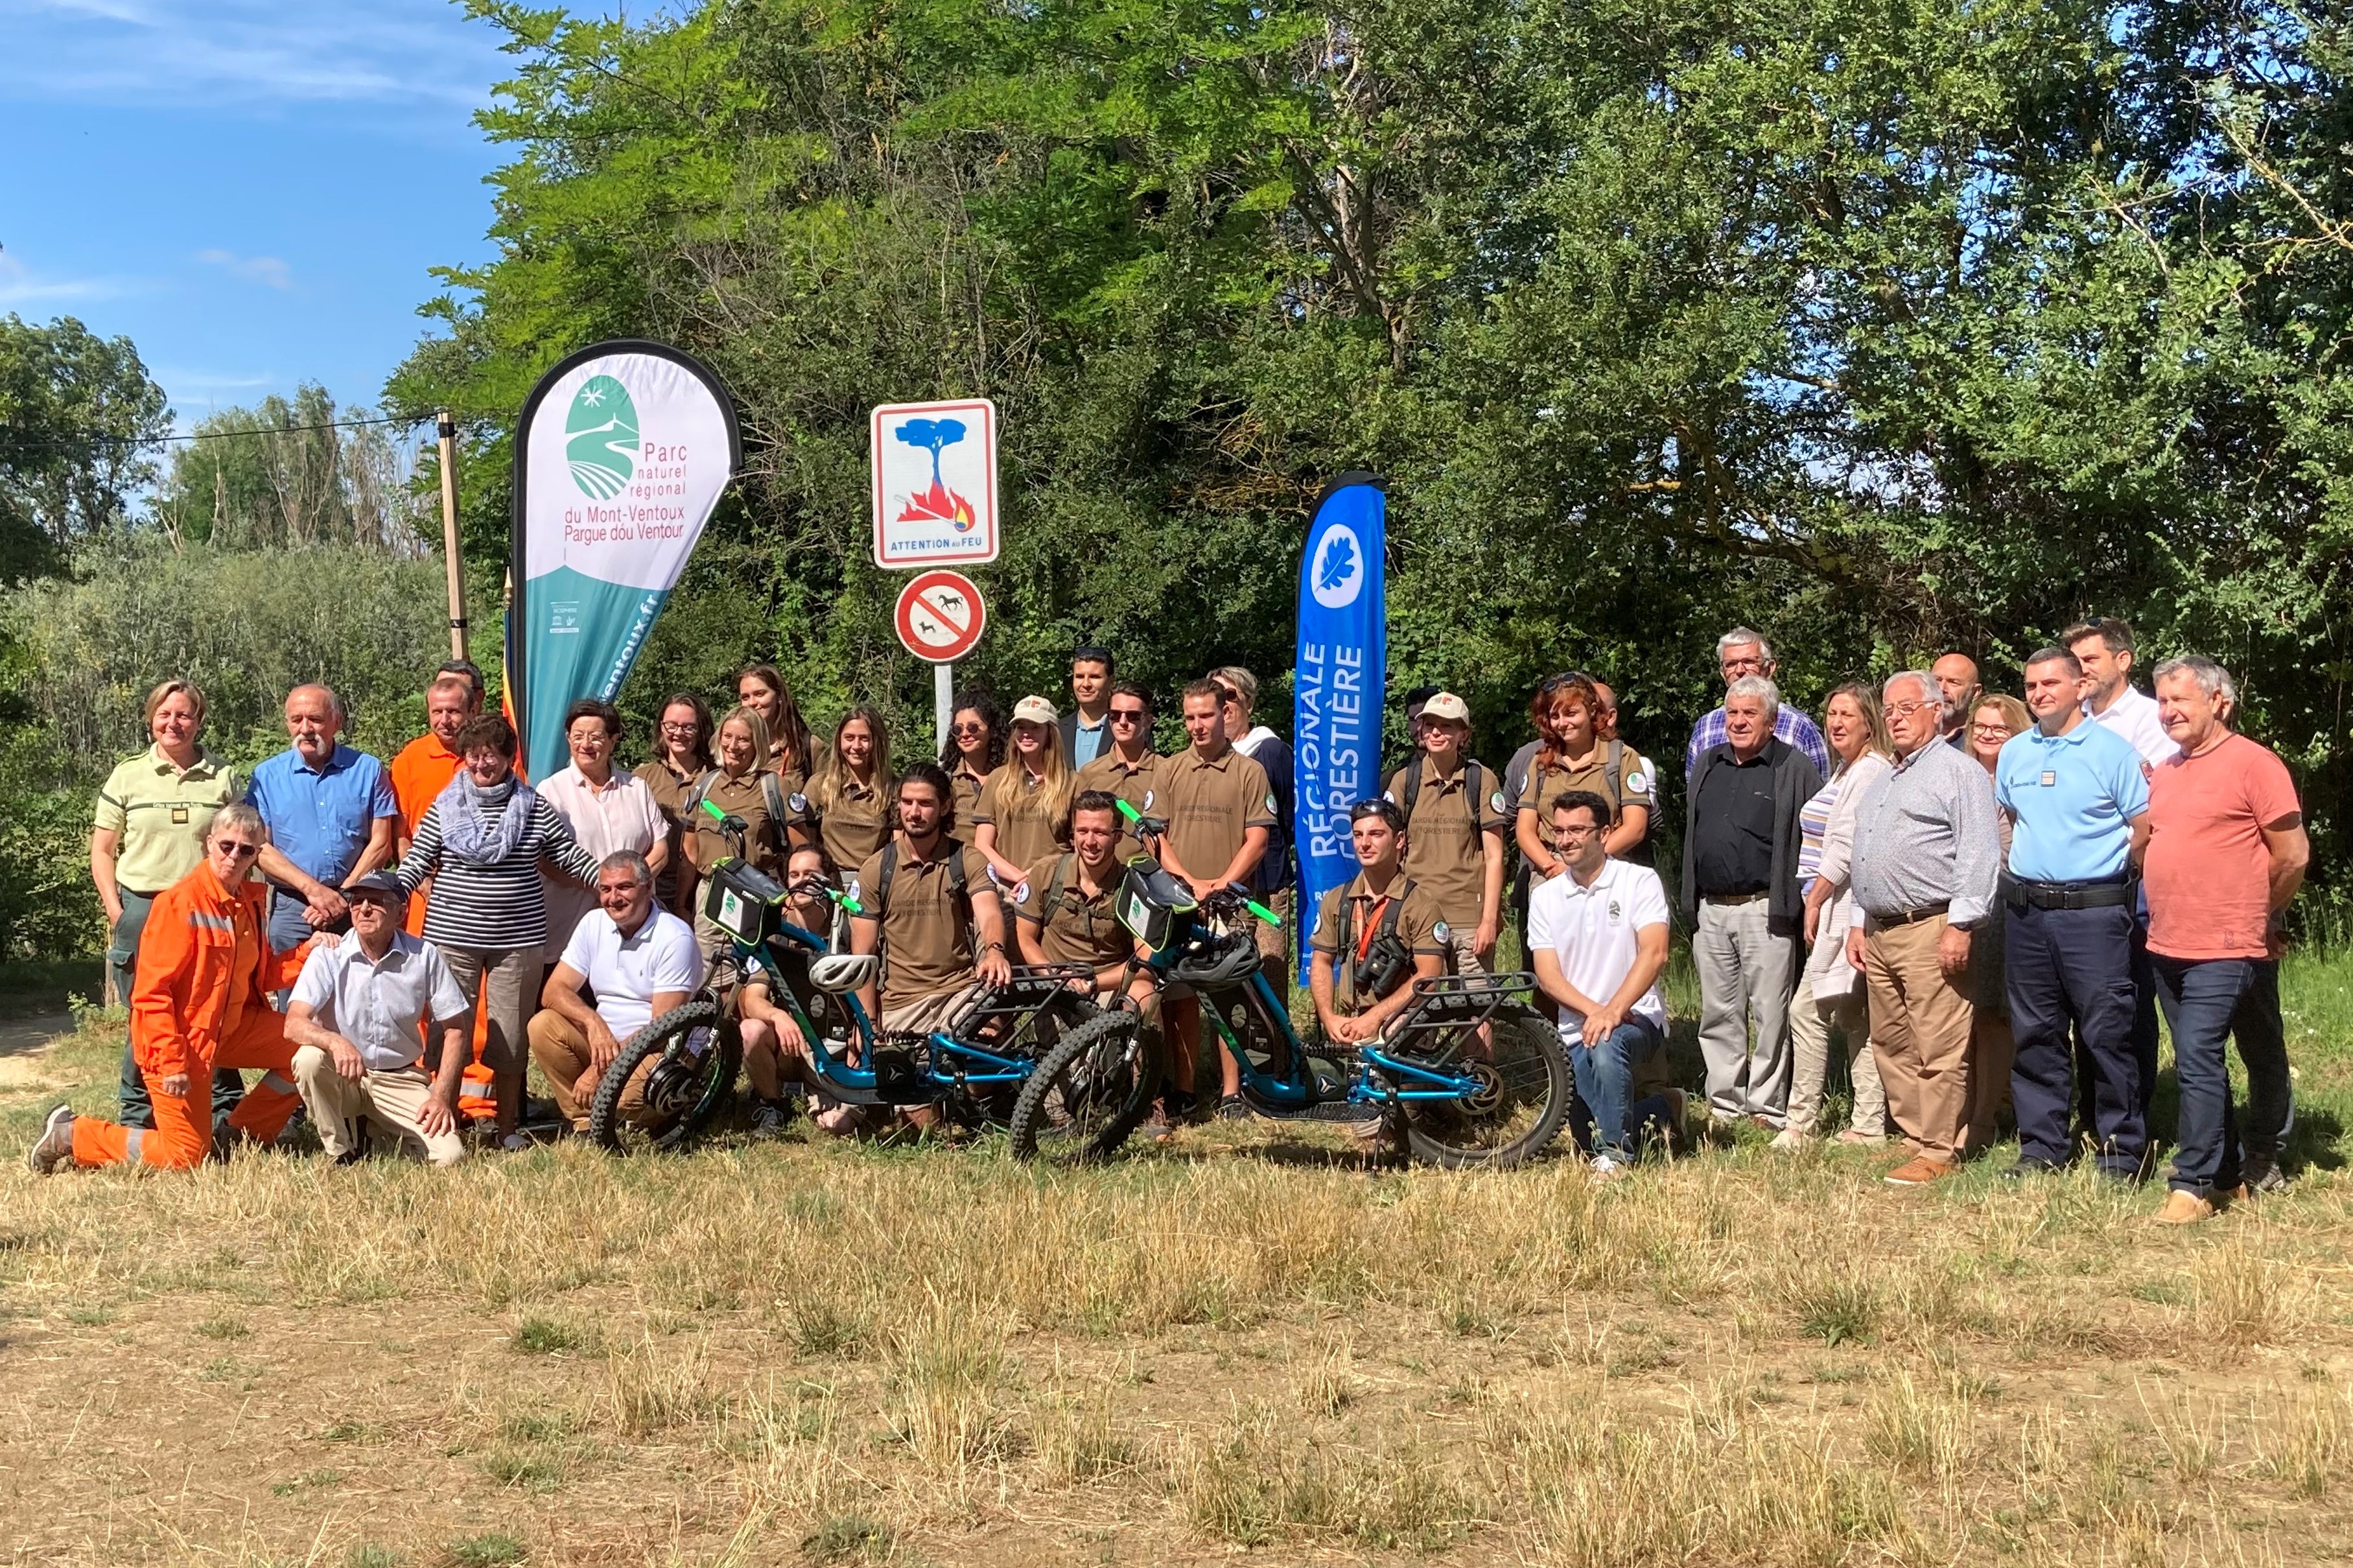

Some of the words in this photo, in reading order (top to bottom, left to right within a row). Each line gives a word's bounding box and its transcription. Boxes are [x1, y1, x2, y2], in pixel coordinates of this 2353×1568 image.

[645, 442, 687, 462] Parc
[638, 464, 686, 480] naturel
[630, 481, 686, 500] régional
[565, 506, 581, 524] du
[588, 504, 685, 522] Mont-Ventoux
[565, 524, 607, 546] Pargue
[638, 523, 685, 540] Ventour
[891, 539, 950, 551] ATTENTION
[961, 537, 982, 547] FEU
[1300, 642, 1337, 857] RÉGIONALE
